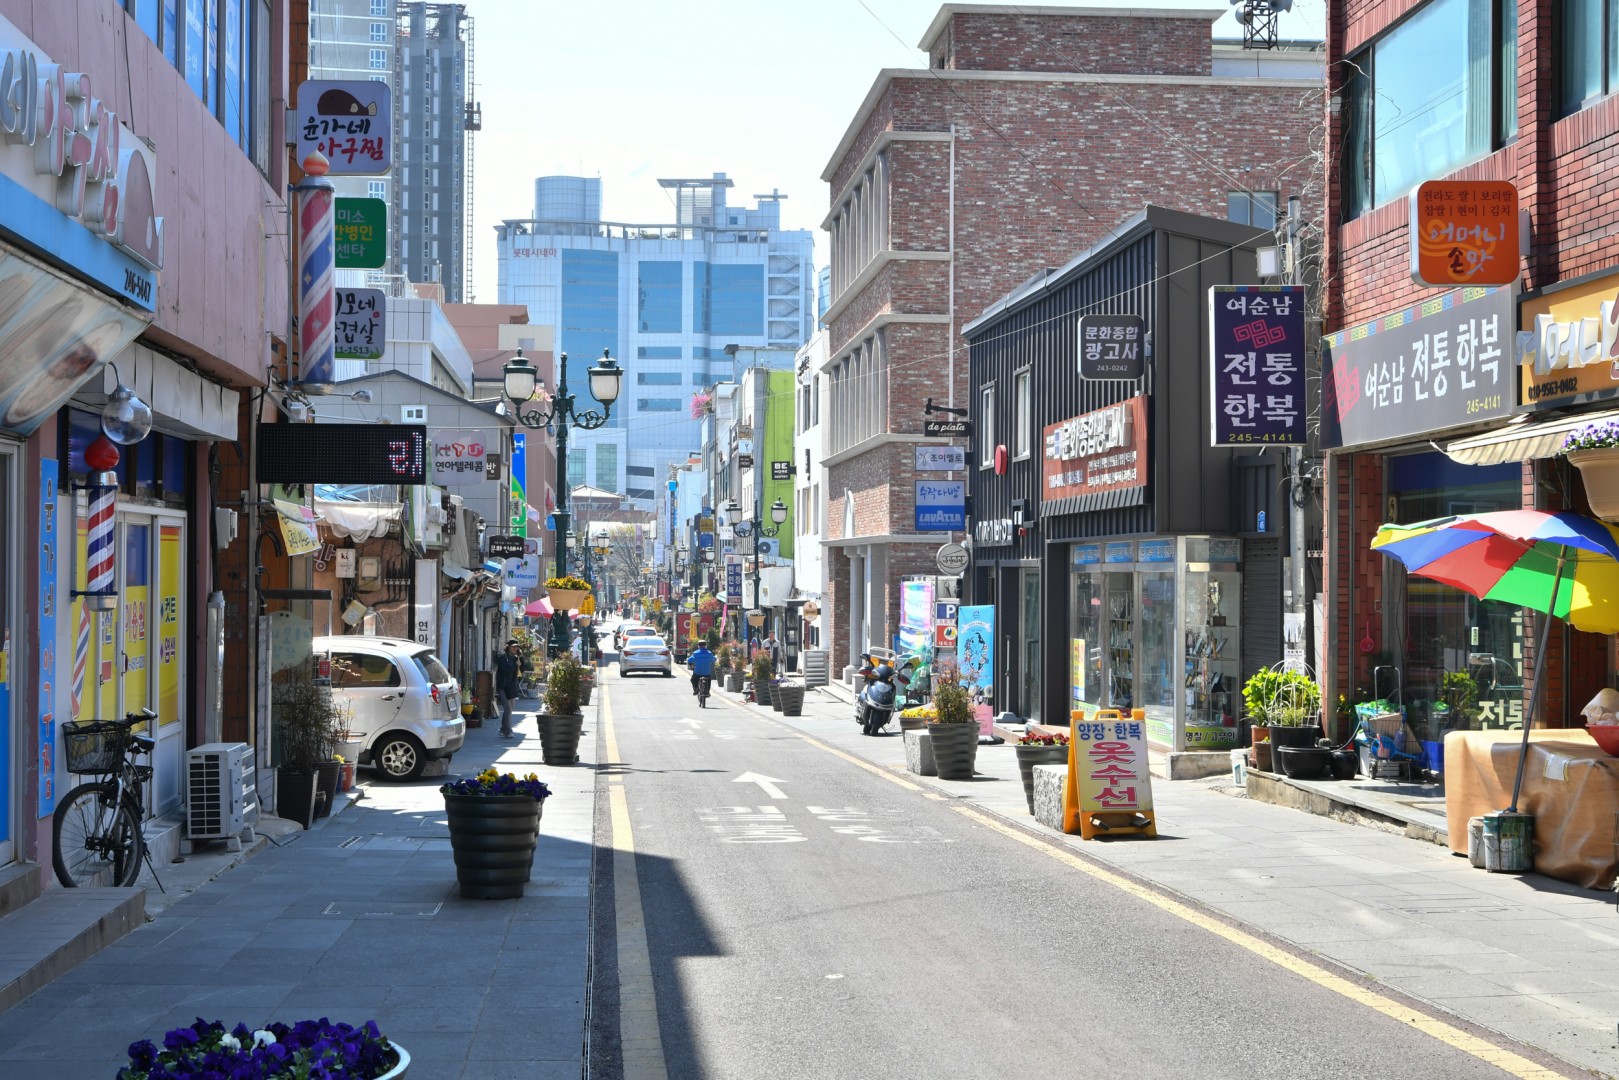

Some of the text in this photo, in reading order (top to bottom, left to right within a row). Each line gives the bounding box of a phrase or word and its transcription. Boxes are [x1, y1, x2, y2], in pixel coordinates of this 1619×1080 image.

[303, 116, 371, 141] 윤가네
[317, 136, 384, 164] 아구찜
[1423, 189, 1513, 202] 전라도 쌀 보리쌀
[337, 209, 365, 223] 미소
[1424, 204, 1511, 217] 찹쌀 현미 김치
[1431, 221, 1505, 243] 어머니
[336, 243, 366, 259] 센타
[512, 247, 557, 258] 롯데시네마
[1448, 246, 1495, 275] 손맛
[1226, 296, 1293, 316] 여순남
[1085, 326, 1139, 340] 문화종합
[1515, 301, 1611, 377] 어머니
[1085, 342, 1139, 361] 광고사
[1222, 351, 1298, 385] 전통
[1364, 313, 1502, 411] 여순남 전통 한복
[1223, 393, 1299, 428] 한복
[1466, 394, 1501, 415] 245-4141
[927, 422, 966, 432] de plata
[1228, 433, 1293, 442] 245-4141
[435, 461, 484, 473] 연아텔레콤
[774, 462, 788, 470] BE
[919, 510, 962, 523] LAVAZZA
[946, 604, 956, 618] P
[42, 478, 55, 800] 윤가네 아구찜
[1088, 741, 1140, 810] 옷수선
